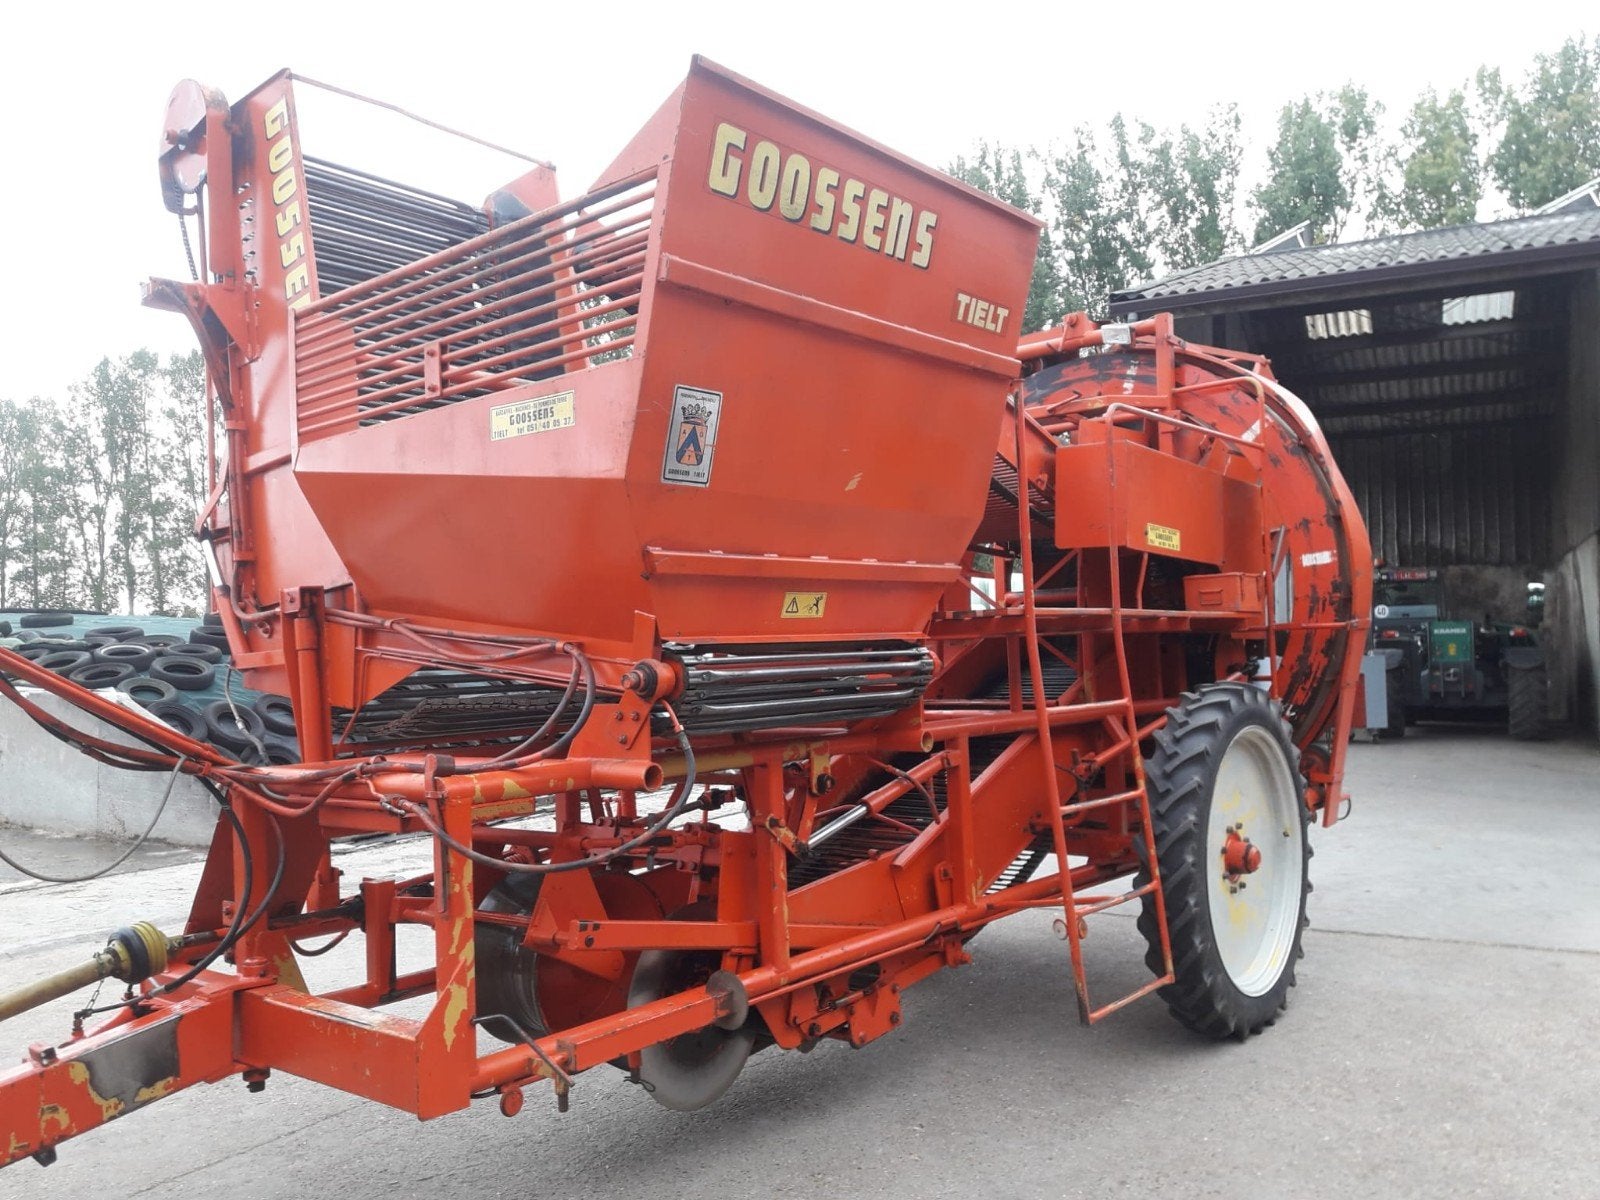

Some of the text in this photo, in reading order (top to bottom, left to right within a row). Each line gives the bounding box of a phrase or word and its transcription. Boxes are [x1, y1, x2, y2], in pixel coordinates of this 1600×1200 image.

[708, 122, 938, 270] GOOSSENS
[956, 292, 1009, 334] TIELT
[509, 406, 555, 426] GOOSSENS
[493, 429, 508, 440] TIELT
[1433, 627, 1467, 635] KRAMER
